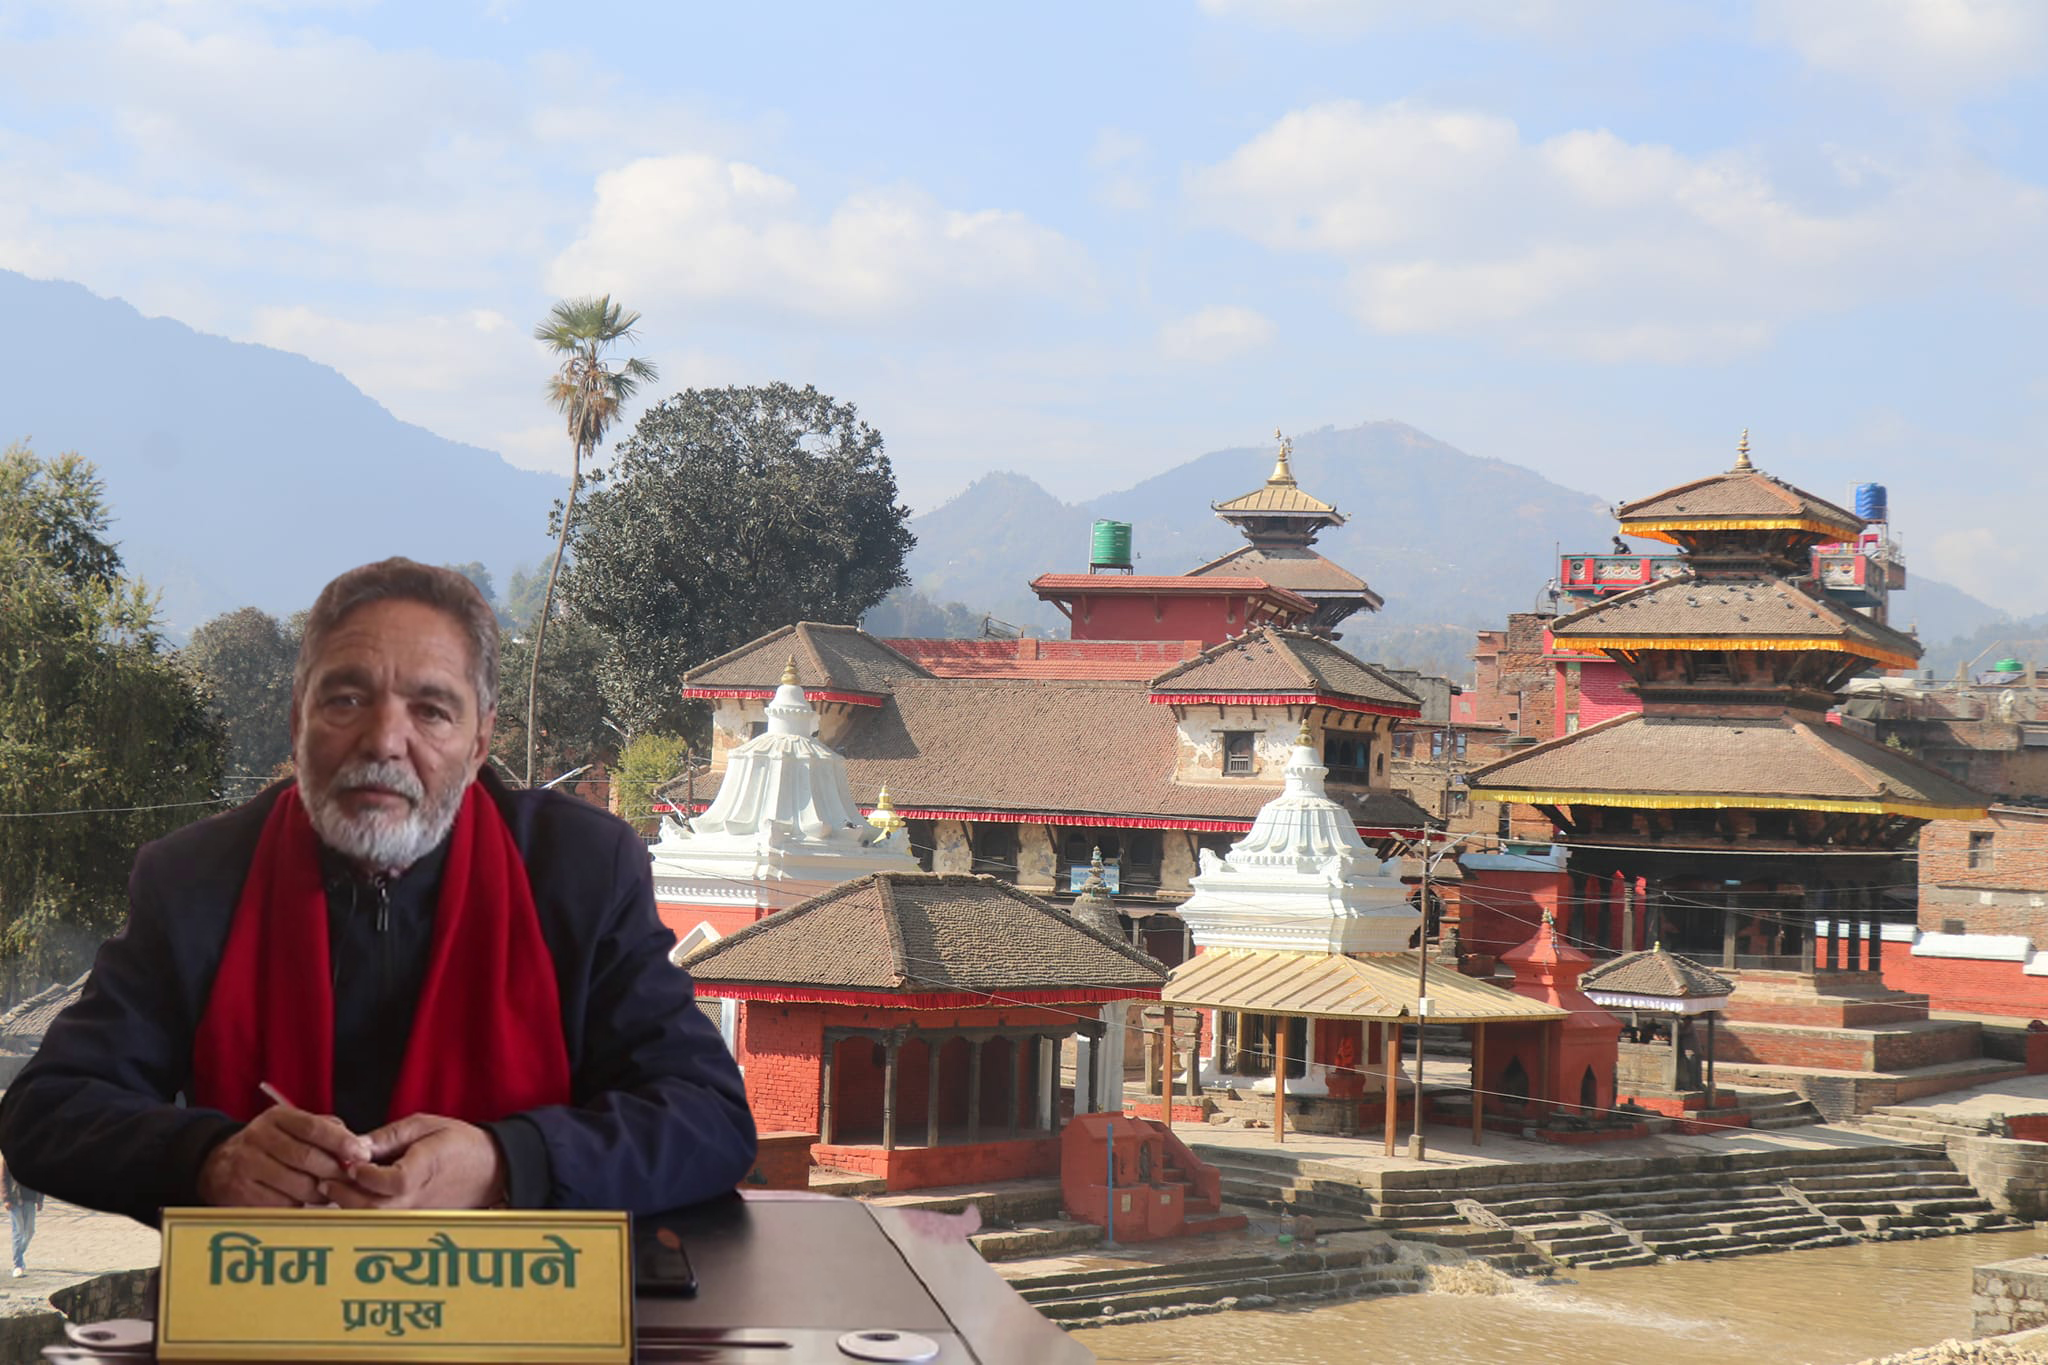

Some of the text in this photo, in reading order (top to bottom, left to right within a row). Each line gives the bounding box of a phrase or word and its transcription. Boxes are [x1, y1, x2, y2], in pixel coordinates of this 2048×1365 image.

[208, 1231, 582, 1288] भिम न्यौपाने
[341, 1299, 446, 1336] प्रमुख
